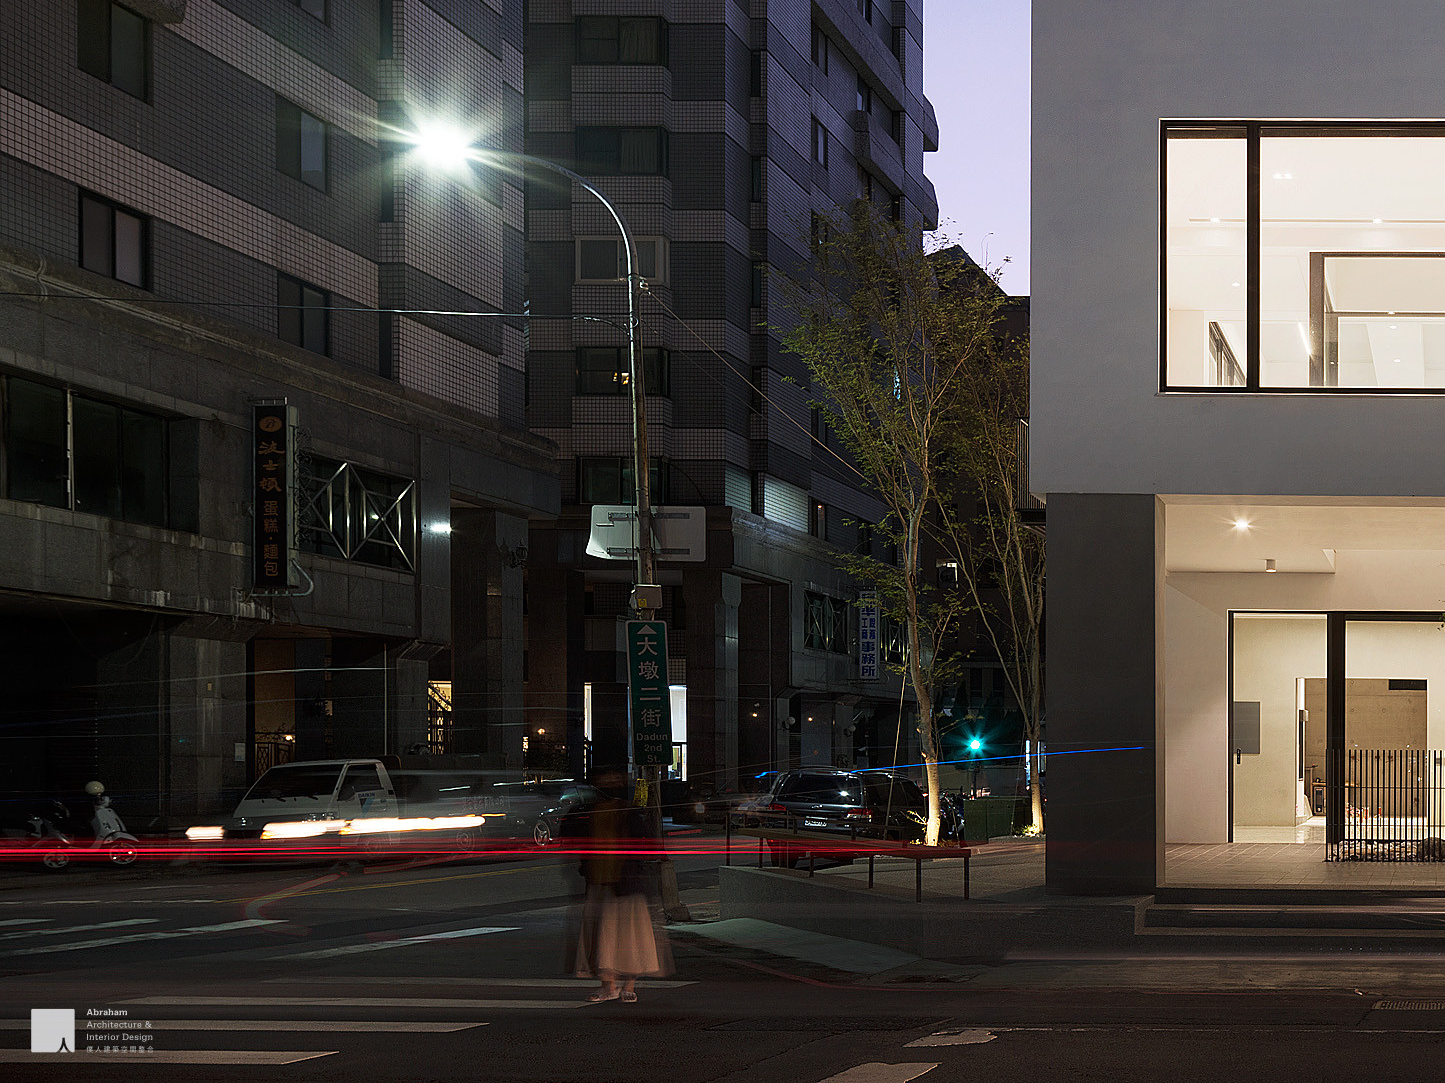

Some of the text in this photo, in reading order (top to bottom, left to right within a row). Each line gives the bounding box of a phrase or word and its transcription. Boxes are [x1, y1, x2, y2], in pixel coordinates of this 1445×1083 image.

[257, 440, 286, 493] 波士頓
[861, 641, 876, 677] 事務所
[636, 636, 662, 728] 大墩二街
[636, 732, 668, 742] Dadun
[643, 743, 663, 753] 2nd
